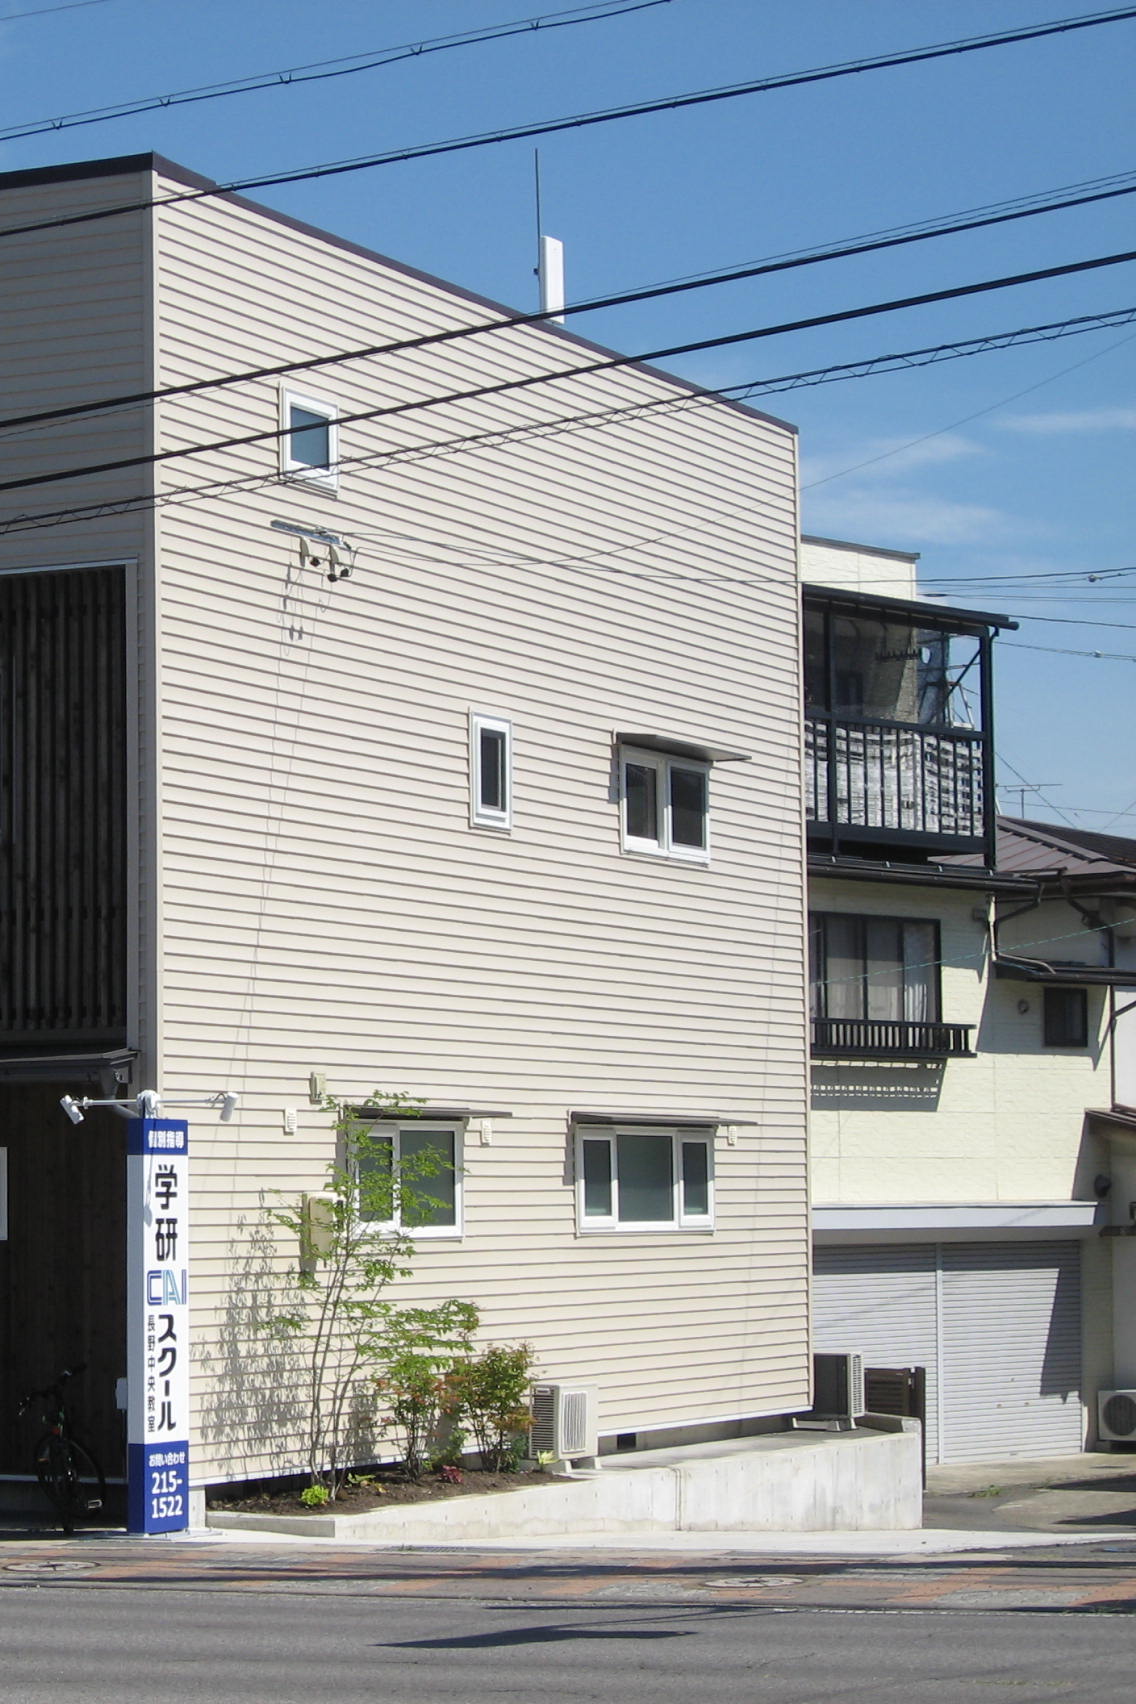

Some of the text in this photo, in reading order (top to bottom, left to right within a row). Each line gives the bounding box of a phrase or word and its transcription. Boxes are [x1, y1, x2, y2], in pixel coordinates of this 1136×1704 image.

[148, 1130, 184, 1148] 個別指導
[155, 1164, 177, 1261] 学研
[147, 1269, 187, 1305] CAI
[147, 1314, 156, 1433] 長野中央教室
[157, 1314, 177, 1431] スクール
[149, 1451, 185, 1467] お問い合わせ
[151, 1470, 183, 1494] 215-
[151, 1495, 183, 1518] 1522
